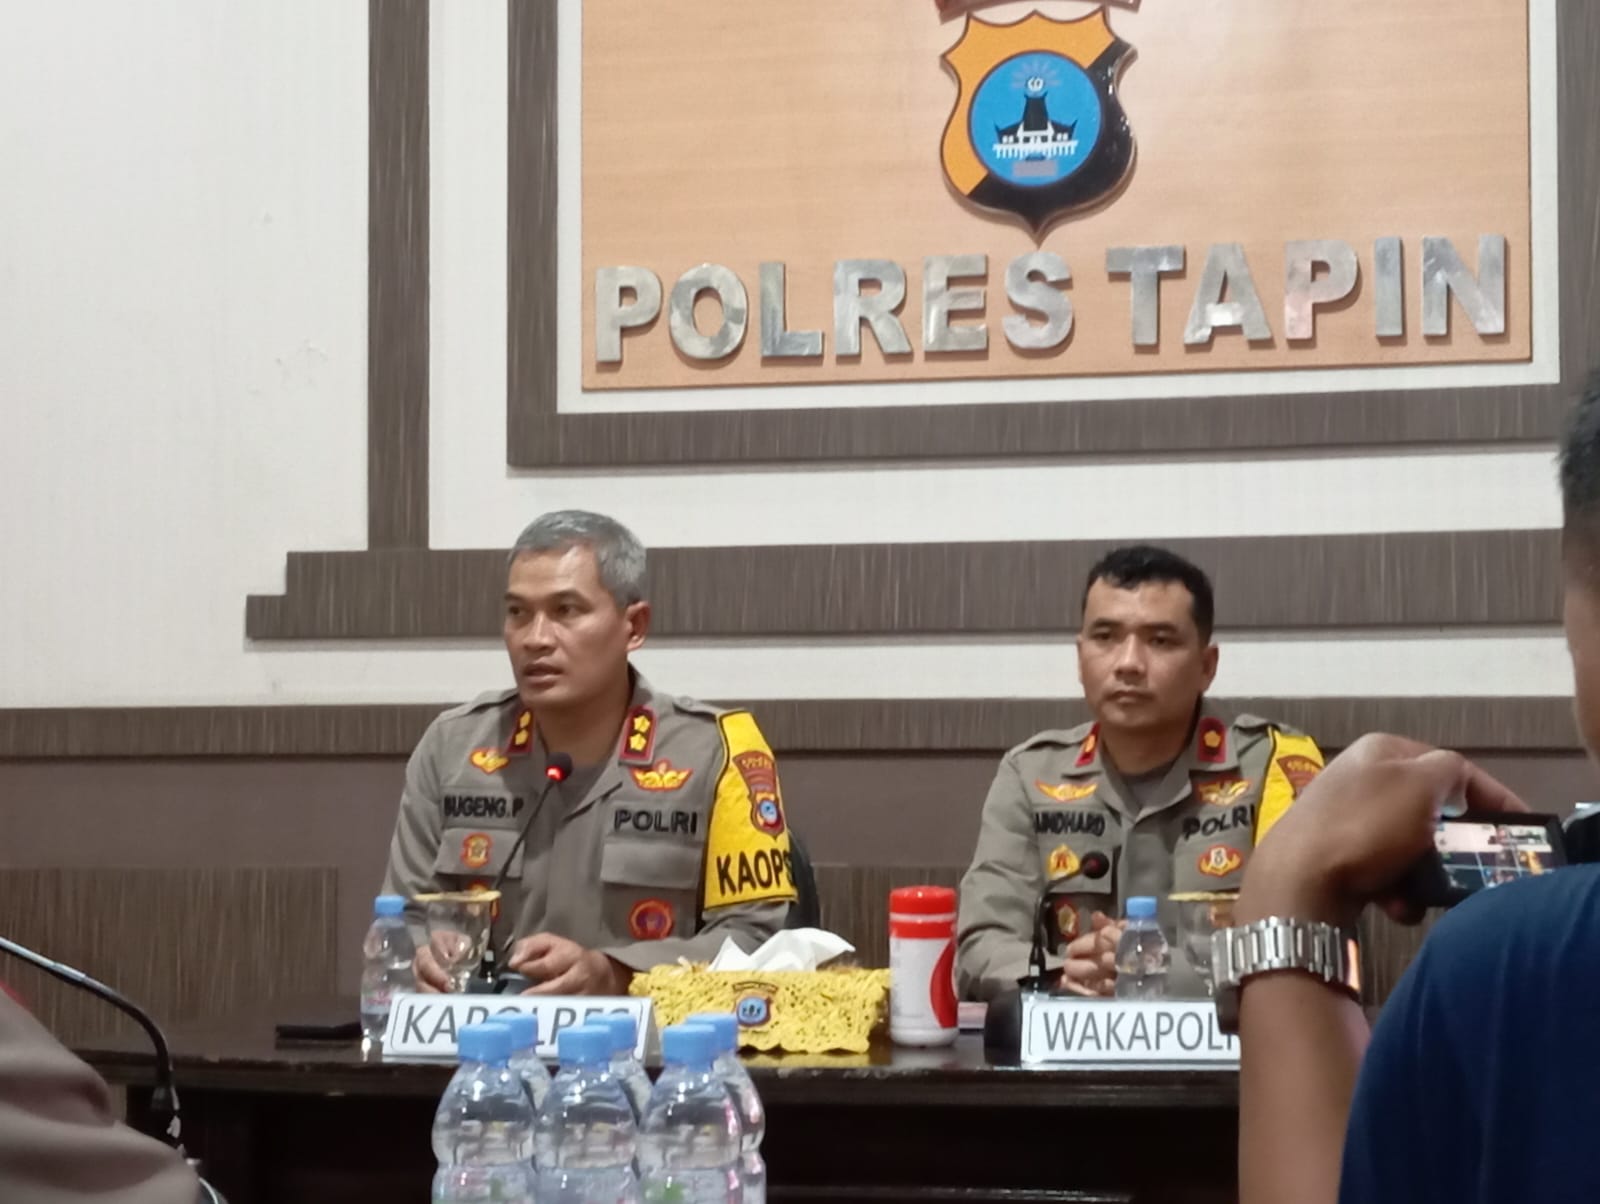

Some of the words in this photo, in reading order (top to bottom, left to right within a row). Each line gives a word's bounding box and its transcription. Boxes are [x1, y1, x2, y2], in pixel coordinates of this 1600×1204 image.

[594, 252, 1074, 365] POLRES
[1105, 234, 1507, 352] TAPIN
[614, 808, 698, 834] POLRI
[1183, 803, 1255, 840] POLRI
[1043, 1011, 1232, 1051] WAKAPOL
